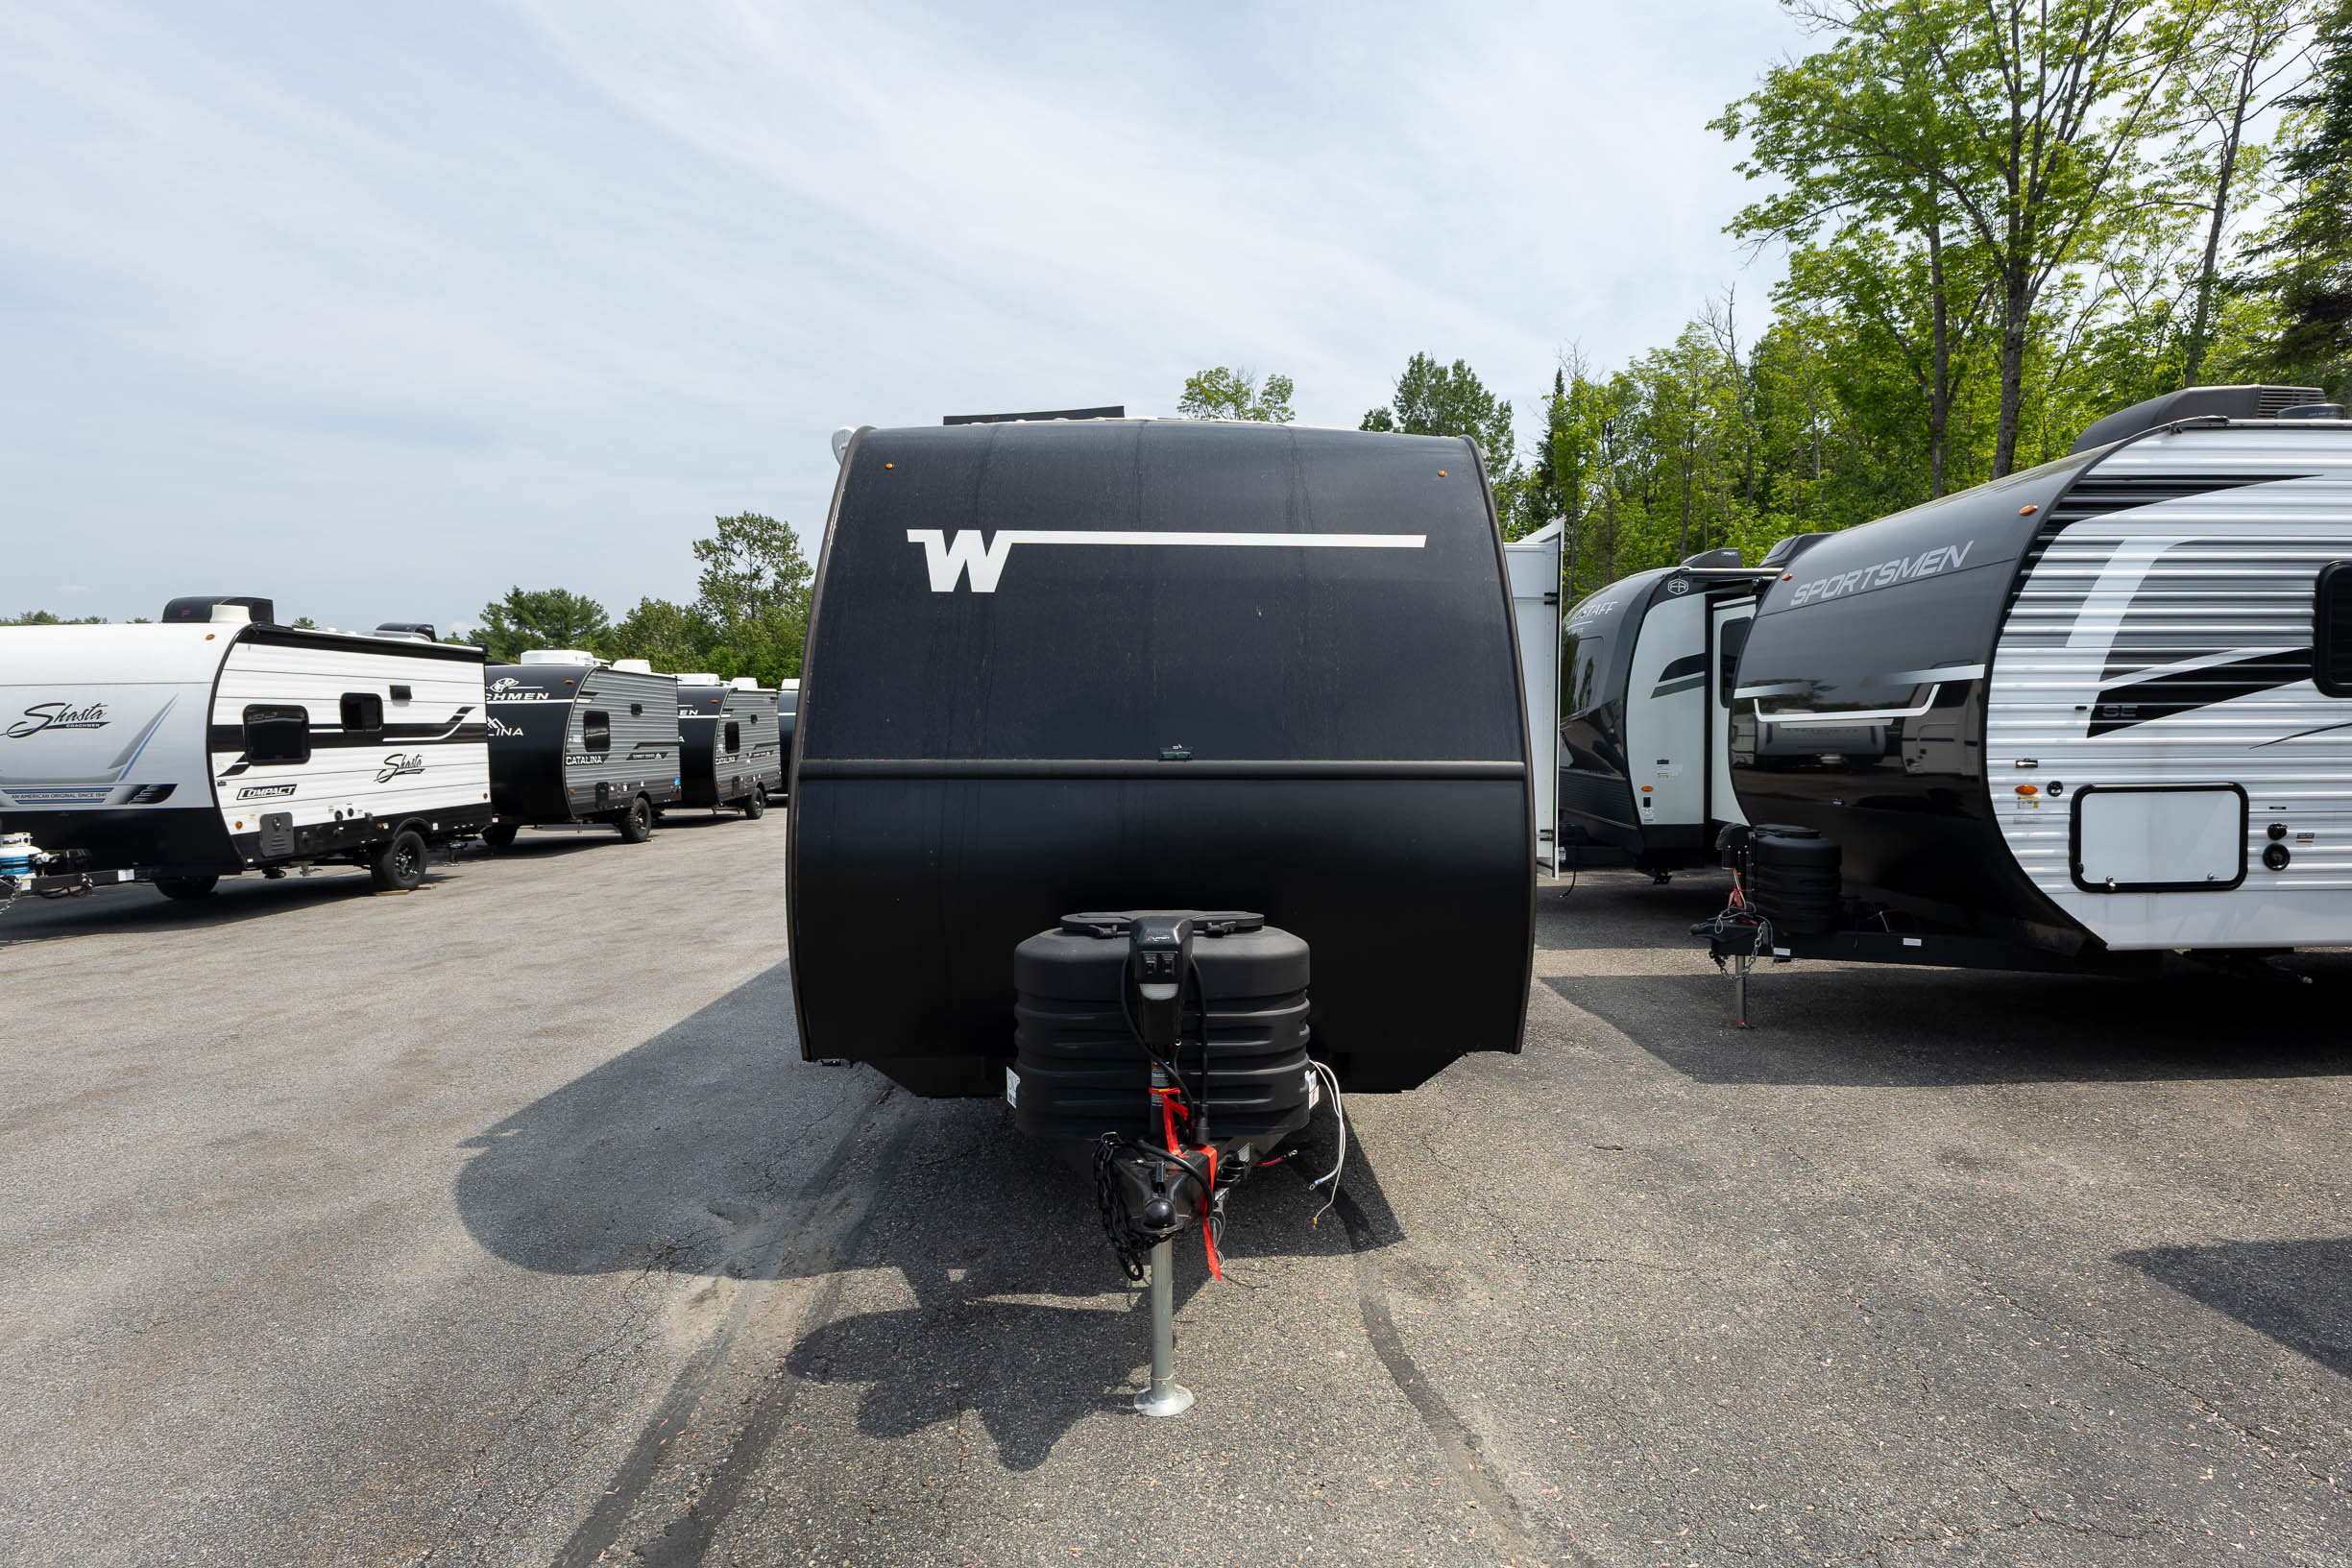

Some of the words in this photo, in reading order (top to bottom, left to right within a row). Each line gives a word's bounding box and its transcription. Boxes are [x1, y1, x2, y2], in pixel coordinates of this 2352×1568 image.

[1789, 540, 1975, 606] SPORTSMEN
[5, 703, 109, 738] Shasta
[2102, 705, 2139, 718] SE
[376, 753, 424, 784] Shasta
[566, 755, 602, 765] CATALINA
[237, 784, 296, 801] COMPACT
